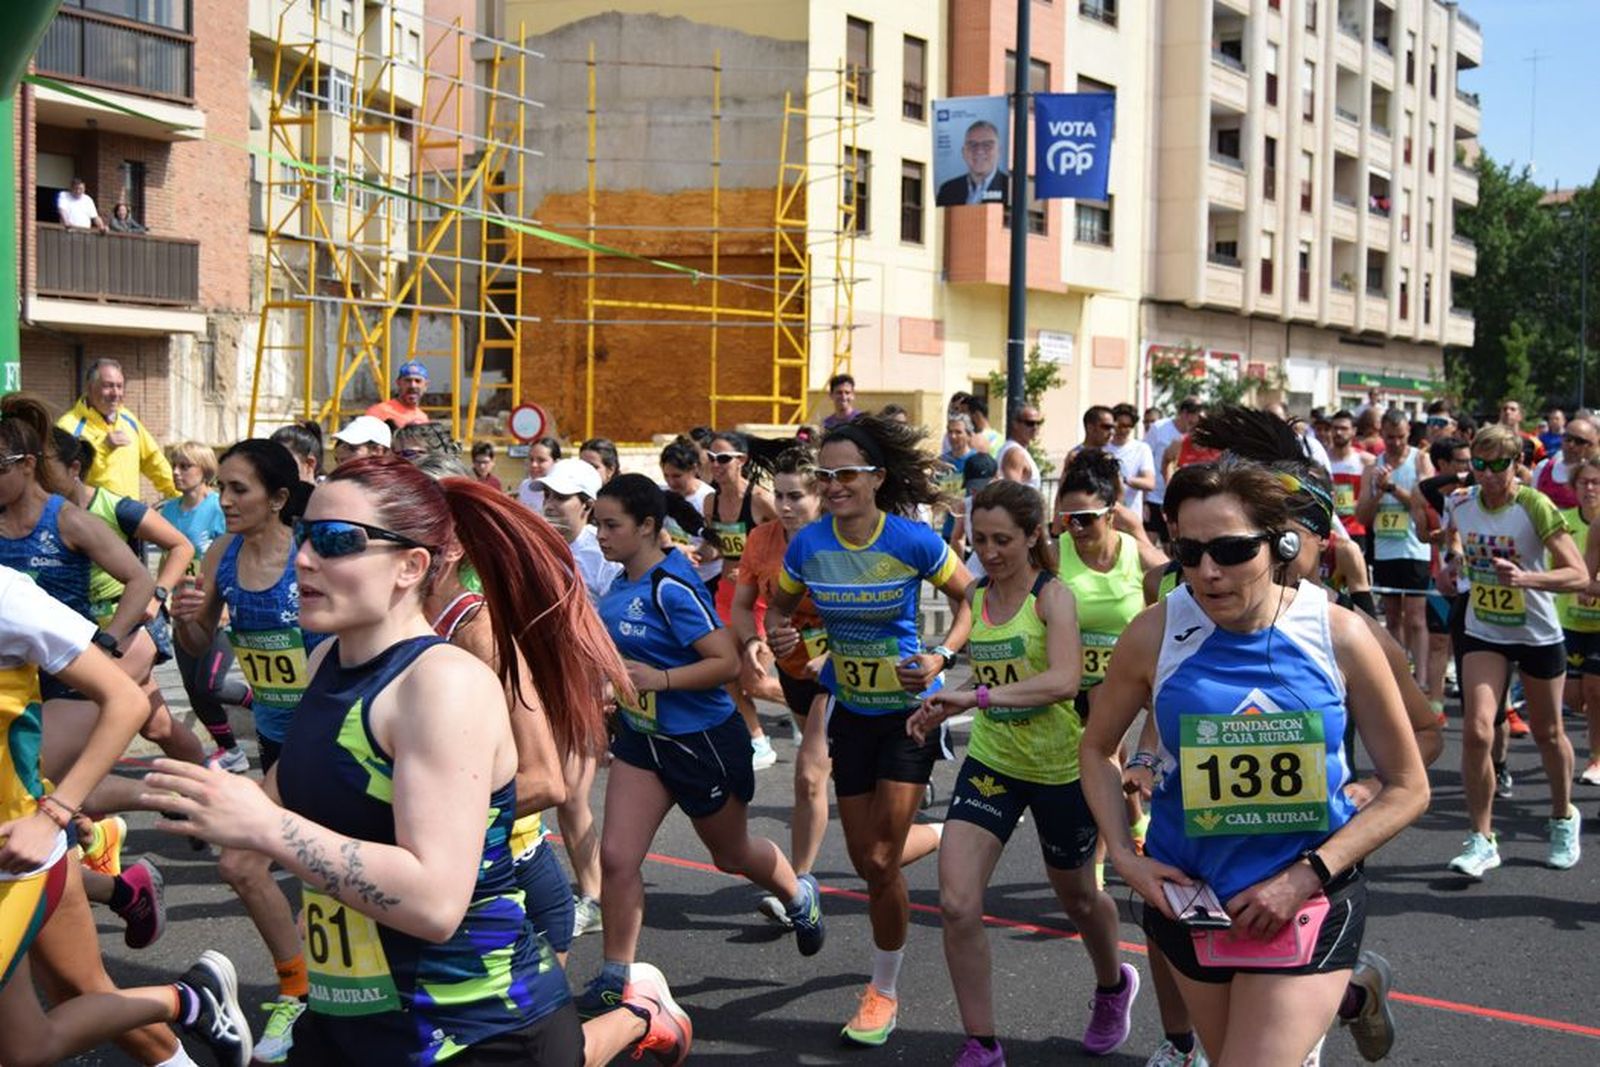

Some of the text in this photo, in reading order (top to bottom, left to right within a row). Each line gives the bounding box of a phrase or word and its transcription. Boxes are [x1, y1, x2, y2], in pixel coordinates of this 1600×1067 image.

[1048, 121, 1097, 137] VOTA
[1382, 514, 1399, 527] 67
[1476, 586, 1514, 610] 212
[243, 653, 296, 683] 179
[844, 661, 880, 688] 37
[1222, 718, 1304, 732] FUNDACION
[1222, 730, 1304, 744] CAJA RURAL
[1197, 752, 1303, 801] 138
[965, 798, 1003, 817] AQUONA
[1226, 810, 1319, 825] CAJA RURAL
[308, 903, 352, 968] 61
[331, 987, 388, 1003] RURAL
